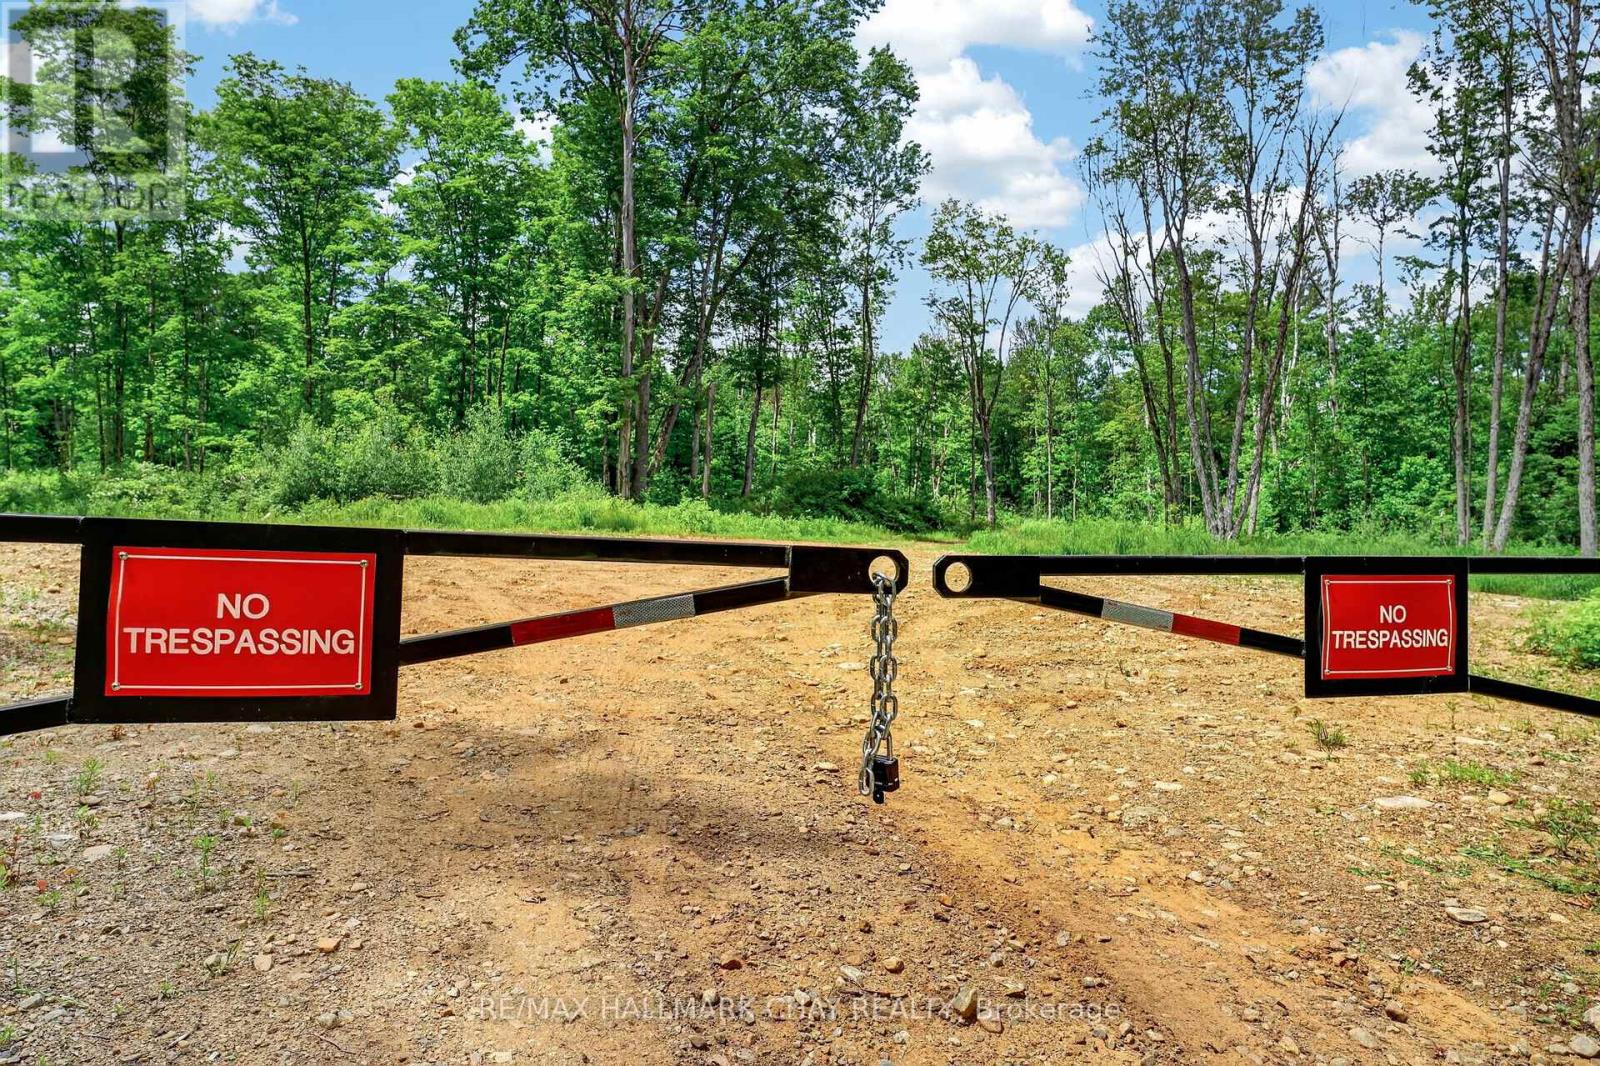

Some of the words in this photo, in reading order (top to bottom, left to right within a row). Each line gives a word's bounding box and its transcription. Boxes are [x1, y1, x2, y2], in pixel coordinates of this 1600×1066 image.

[216, 593, 270, 619] NO
[1379, 604, 1407, 624] NO
[122, 627, 356, 655] TRESPASSING
[1331, 628, 1449, 649] TRESPASSING
